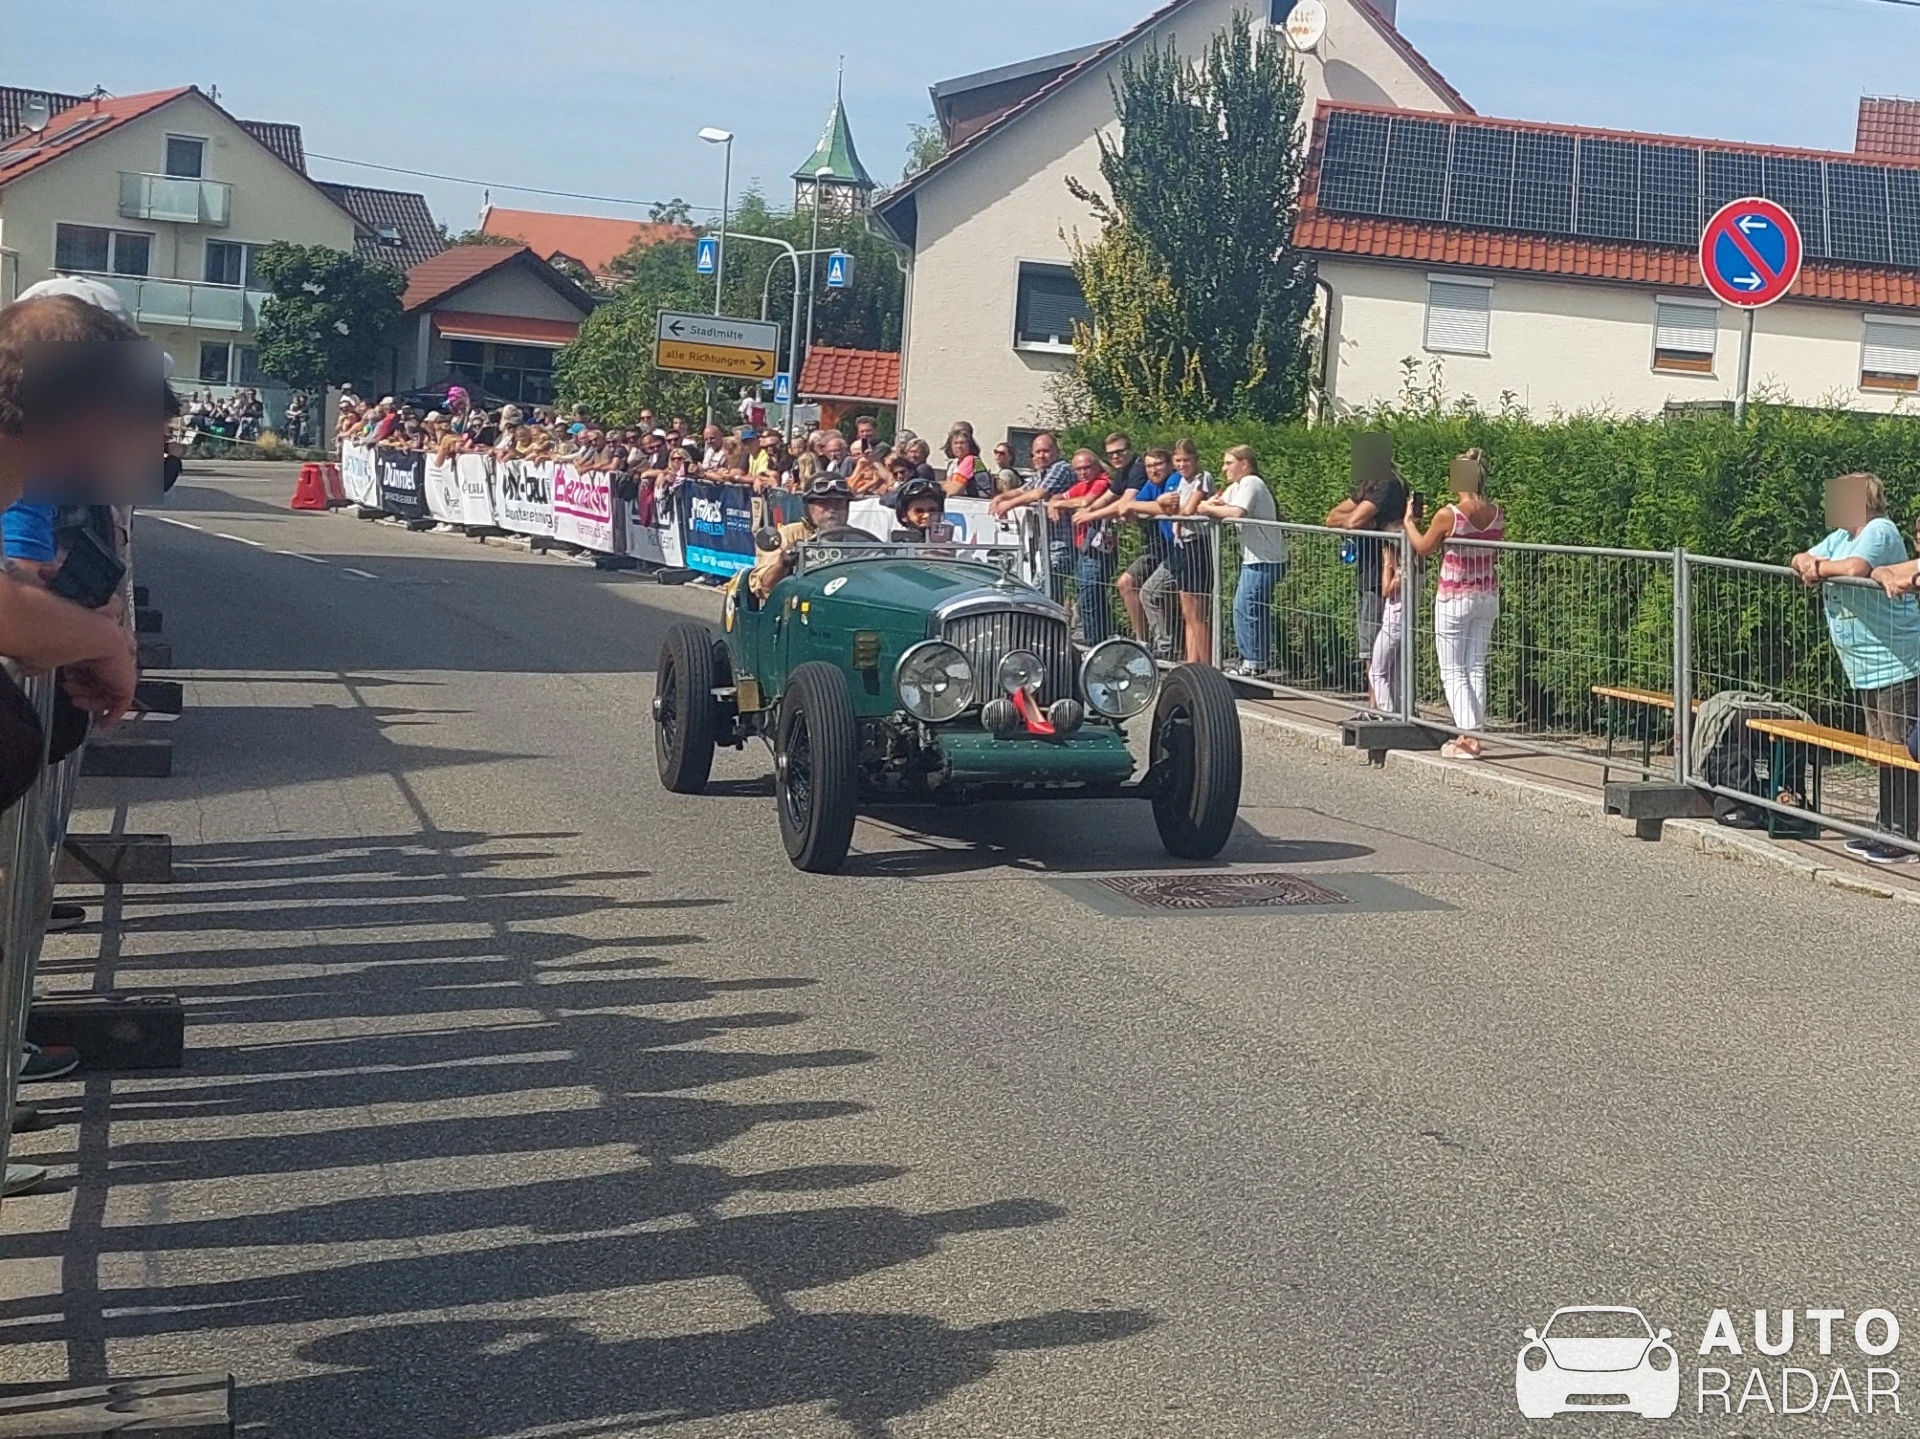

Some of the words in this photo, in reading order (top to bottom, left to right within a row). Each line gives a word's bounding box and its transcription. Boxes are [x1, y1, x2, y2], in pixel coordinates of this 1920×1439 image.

[690, 325, 744, 340] Stadtmitte
[666, 349, 685, 360] alle
[688, 351, 746, 367] Richtungen
